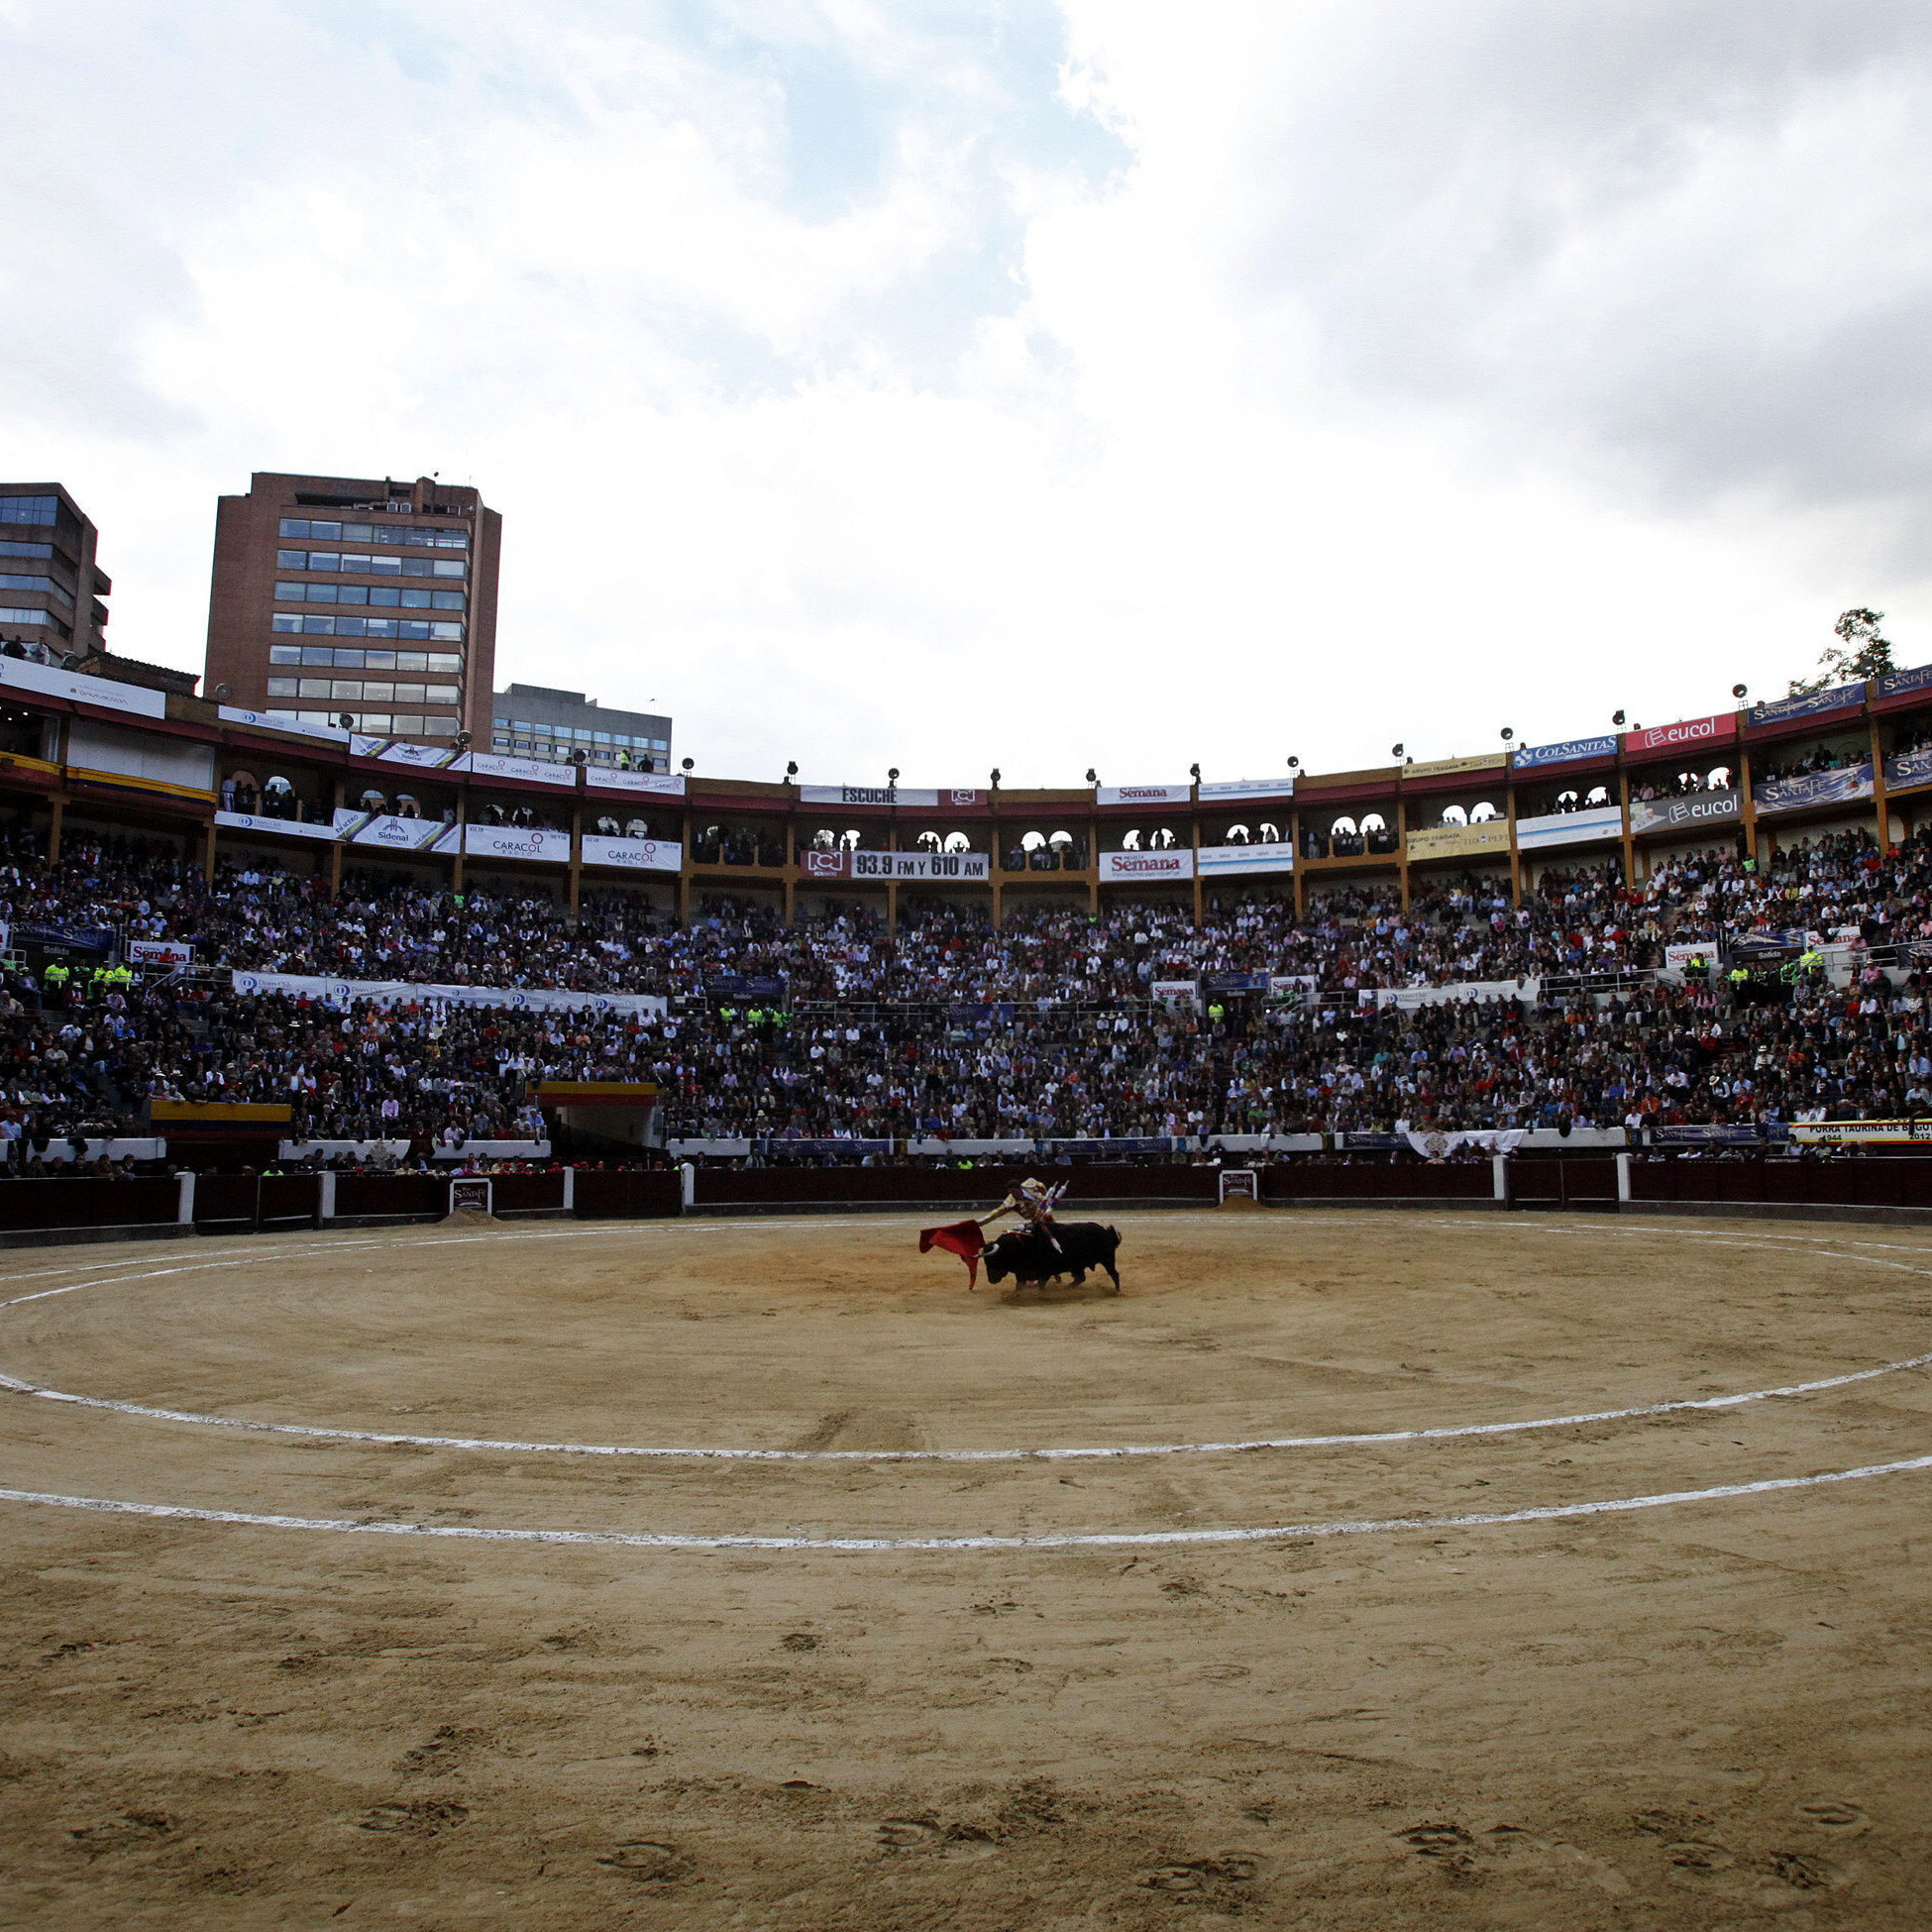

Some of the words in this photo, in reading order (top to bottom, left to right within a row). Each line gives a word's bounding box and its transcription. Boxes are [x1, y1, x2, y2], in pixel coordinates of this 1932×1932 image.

[1667, 717, 1715, 742] eucol
[401, 753, 422, 762] Sidenal
[478, 762, 504, 771] CARACOL
[511, 767, 538, 776] CARACOL
[545, 772, 571, 781] CARACOL
[842, 788, 897, 804] ESCUCHE
[1119, 787, 1168, 799] Semana
[1691, 795, 1738, 817] eucol
[377, 831, 409, 842] Sidenal
[492, 840, 543, 853] CARACOL
[607, 850, 654, 862] CARACOL
[857, 855, 892, 875] 93.9
[898, 861, 914, 875] FM
[915, 861, 926, 875] Y
[931, 855, 959, 876] 610
[964, 862, 984, 876] AM
[1111, 855, 1180, 872] Semana
[44, 945, 69, 956] Salida
